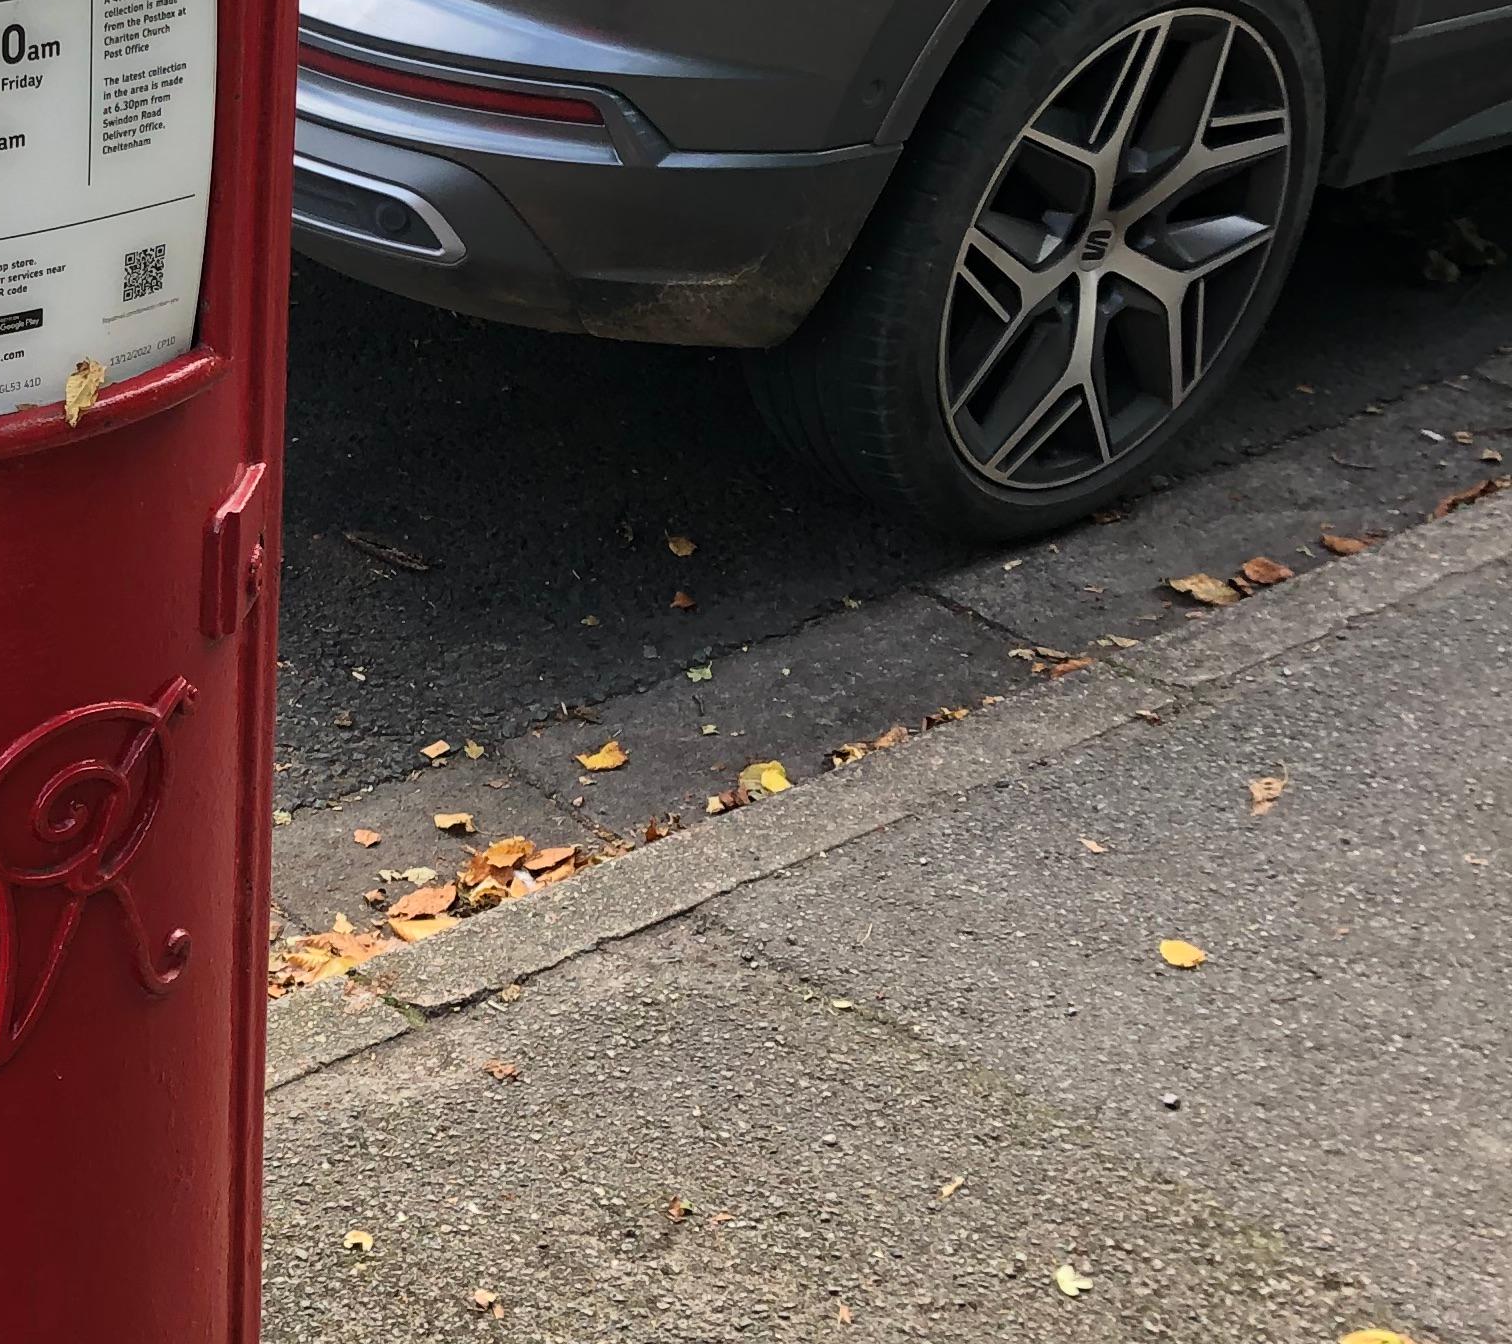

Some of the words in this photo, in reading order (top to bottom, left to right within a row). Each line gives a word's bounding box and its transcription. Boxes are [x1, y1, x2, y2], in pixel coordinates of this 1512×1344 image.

[104, 3, 143, 18] collection
[147, 0, 153, 9] is
[104, 21, 124, 32] from
[127, 18, 140, 27] the
[144, 11, 175, 24] Postbox
[178, 8, 186, 16] at
[143, 24, 170, 38] Church
[104, 48, 122, 59] Post
[125, 44, 149, 55] Office
[2, 74, 43, 92] Friday
[104, 77, 119, 86] The
[122, 70, 145, 82] latest
[148, 62, 186, 77] collection
[104, 91, 111, 100] in
[114, 89, 127, 98] the
[131, 84, 148, 94] area
[152, 81, 158, 90] is
[161, 76, 183, 87] made
[103, 106, 111, 115] at
[115, 99, 148, 113] 6.30pm
[151, 93, 170, 104] from
[103, 115, 138, 128] Swindon
[141, 108, 161, 120] Road
[103, 127, 136, 142] Delivery
[103, 138, 151, 154] Cheltenham
[8, 270, 43, 283] services
[47, 264, 66, 275] near
[7, 284, 28, 295] code
[0, 322, 24, 331] Google
[26, 318, 40, 326] Play
[0, 381, 21, 394] GL53
